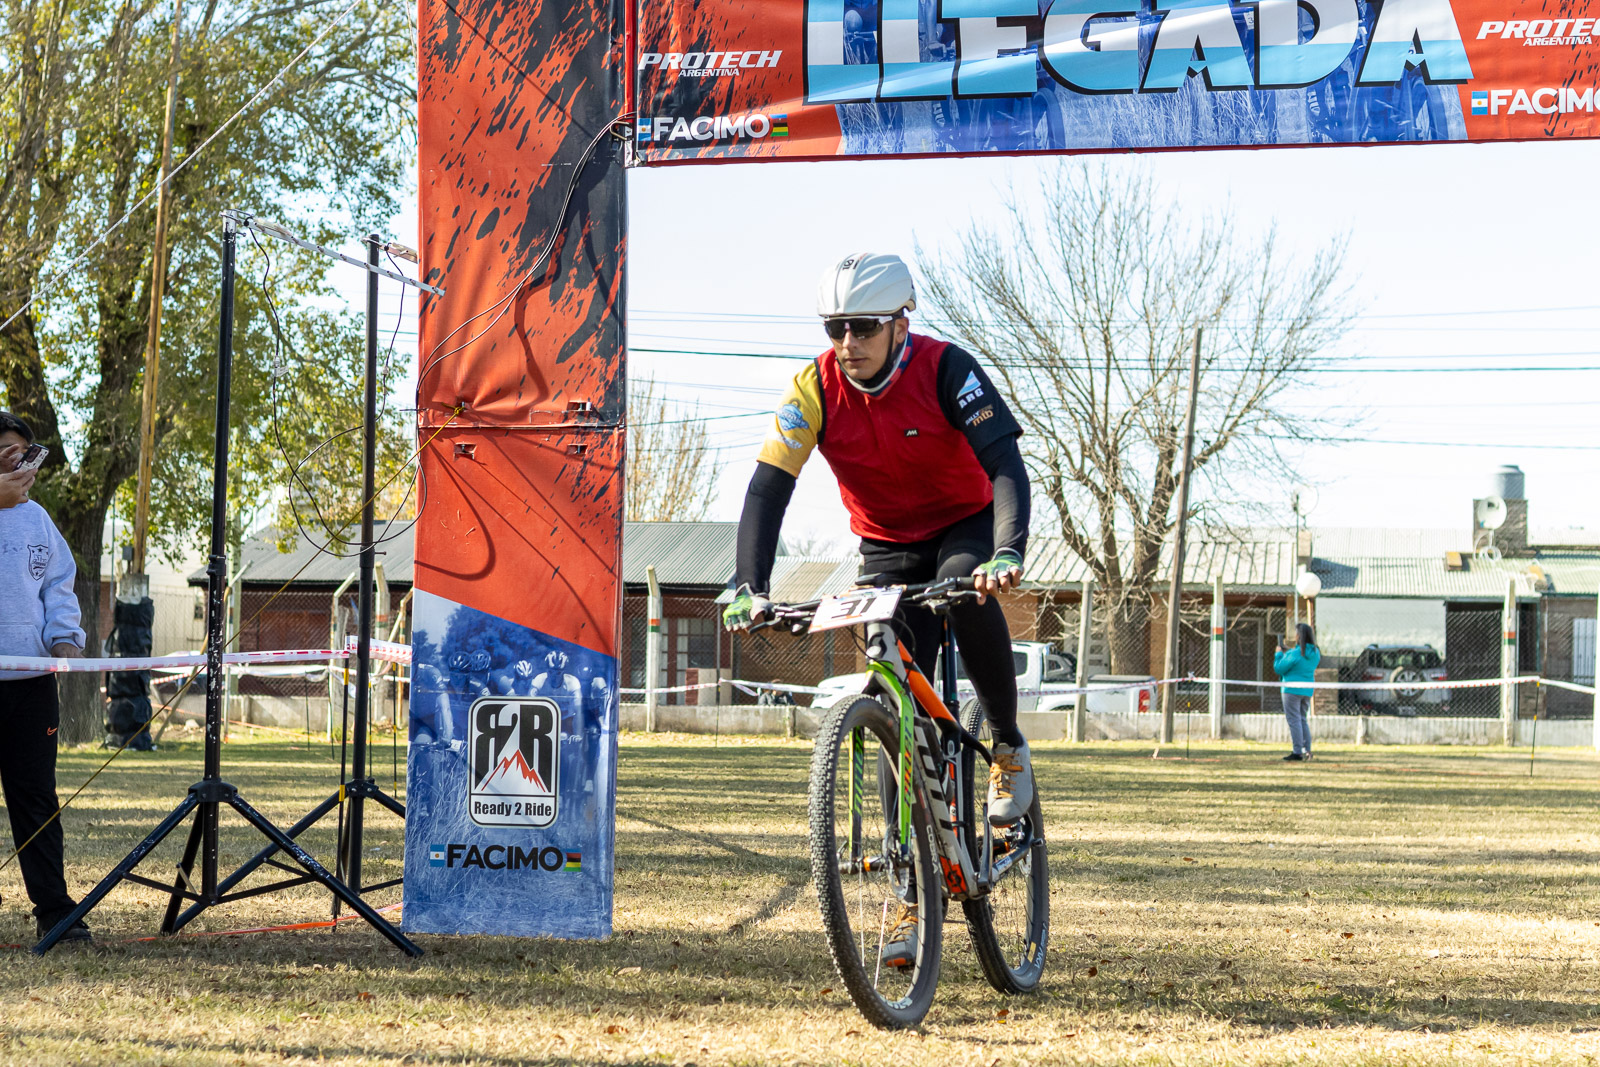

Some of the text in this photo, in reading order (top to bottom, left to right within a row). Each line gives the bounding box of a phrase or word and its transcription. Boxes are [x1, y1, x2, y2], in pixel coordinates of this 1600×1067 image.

[1522, 36, 1593, 47] ARGENTINA
[638, 51, 782, 70] PROTECH
[678, 68, 740, 77] ARGENTINA
[1490, 87, 1600, 116] FACIM
[653, 113, 770, 142] FACIMO
[959, 388, 984, 408] ARG
[831, 597, 877, 619] 31
[474, 801, 552, 817] Ready 2 Ride
[447, 844, 564, 871] FACIMO
